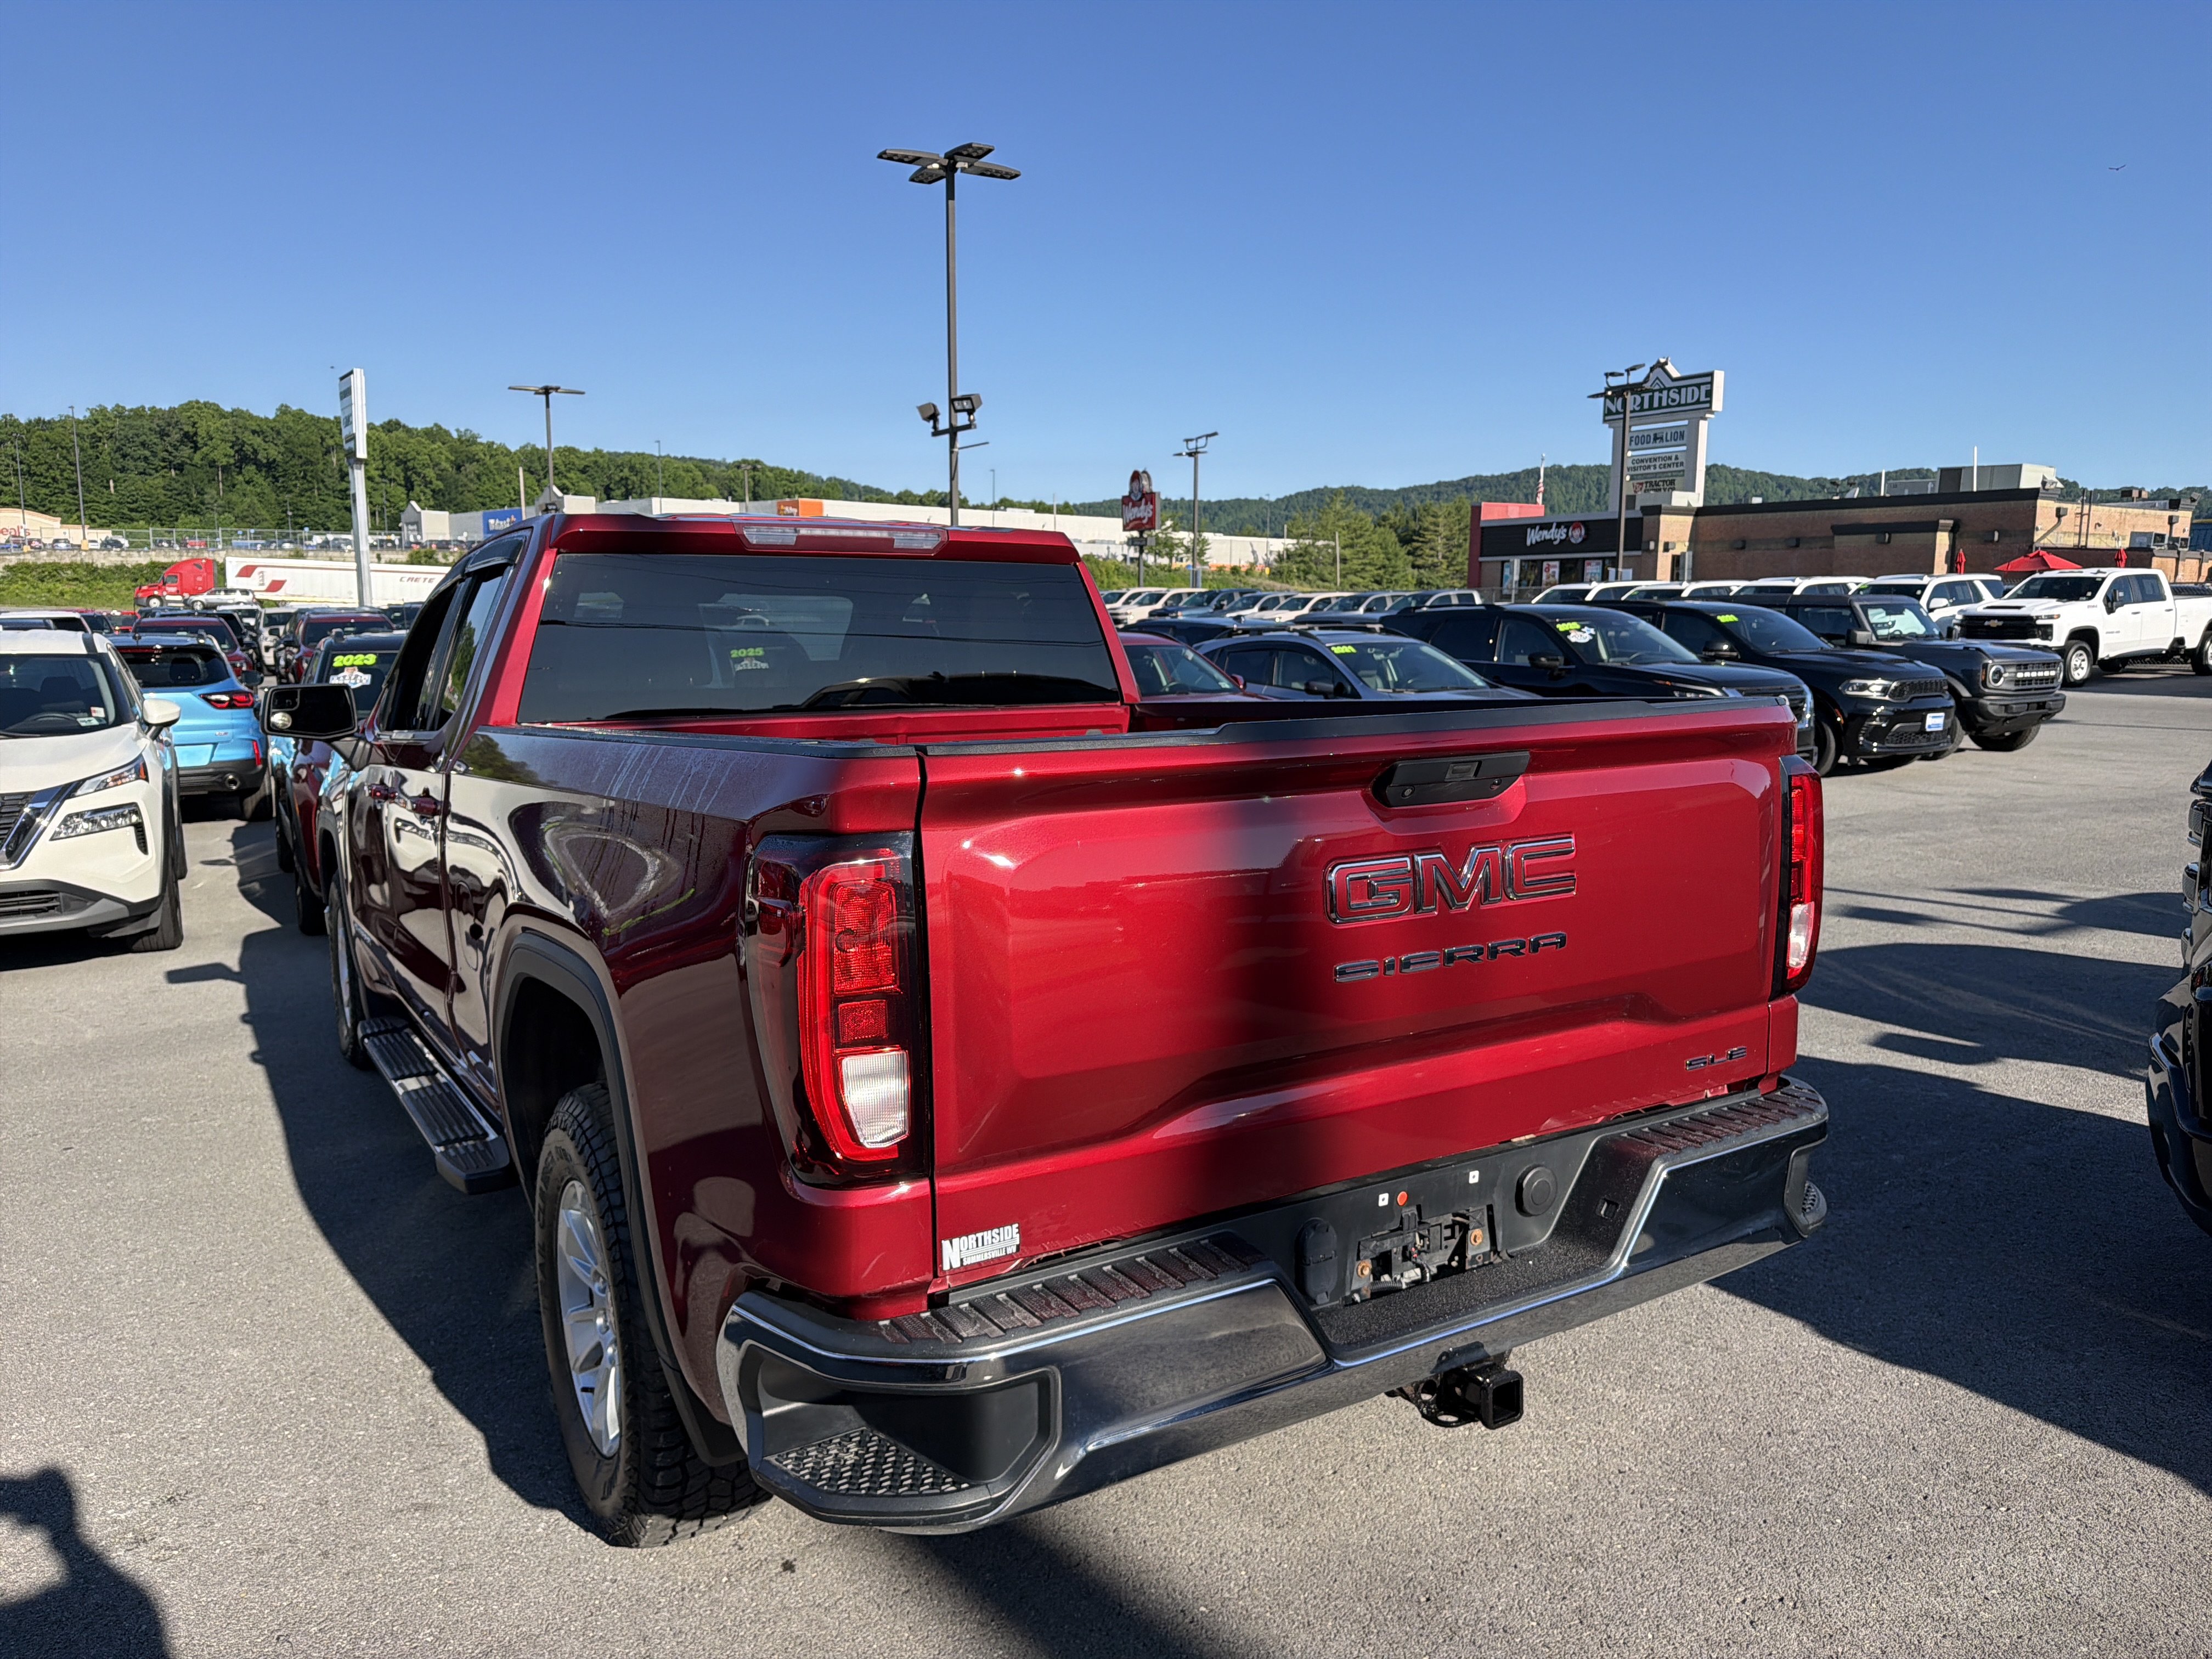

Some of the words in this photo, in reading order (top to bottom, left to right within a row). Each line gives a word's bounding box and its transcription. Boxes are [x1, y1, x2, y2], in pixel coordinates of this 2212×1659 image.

[1605, 383, 1711, 414] NORTHSIDE
[1629, 433, 1651, 446] FOOD
[1665, 431, 1685, 442] LION
[1631, 455, 1673, 465] CONVENTION
[1658, 461, 1684, 470] CENTER
[1645, 479, 1675, 488] TRACTOR
[1527, 522, 1567, 546] Wendy's
[332, 653, 377, 667] 2023
[730, 647, 764, 658] 2025
[1323, 832, 1577, 928] GMC
[1334, 932, 1567, 983] SIERRA
[1685, 1046, 1747, 1070] SLE
[941, 1223, 1020, 1271] NORTHSIDE
[963, 1247, 1006, 1266] SUMMERSVILLE
[1006, 1244, 1017, 1255] WV
